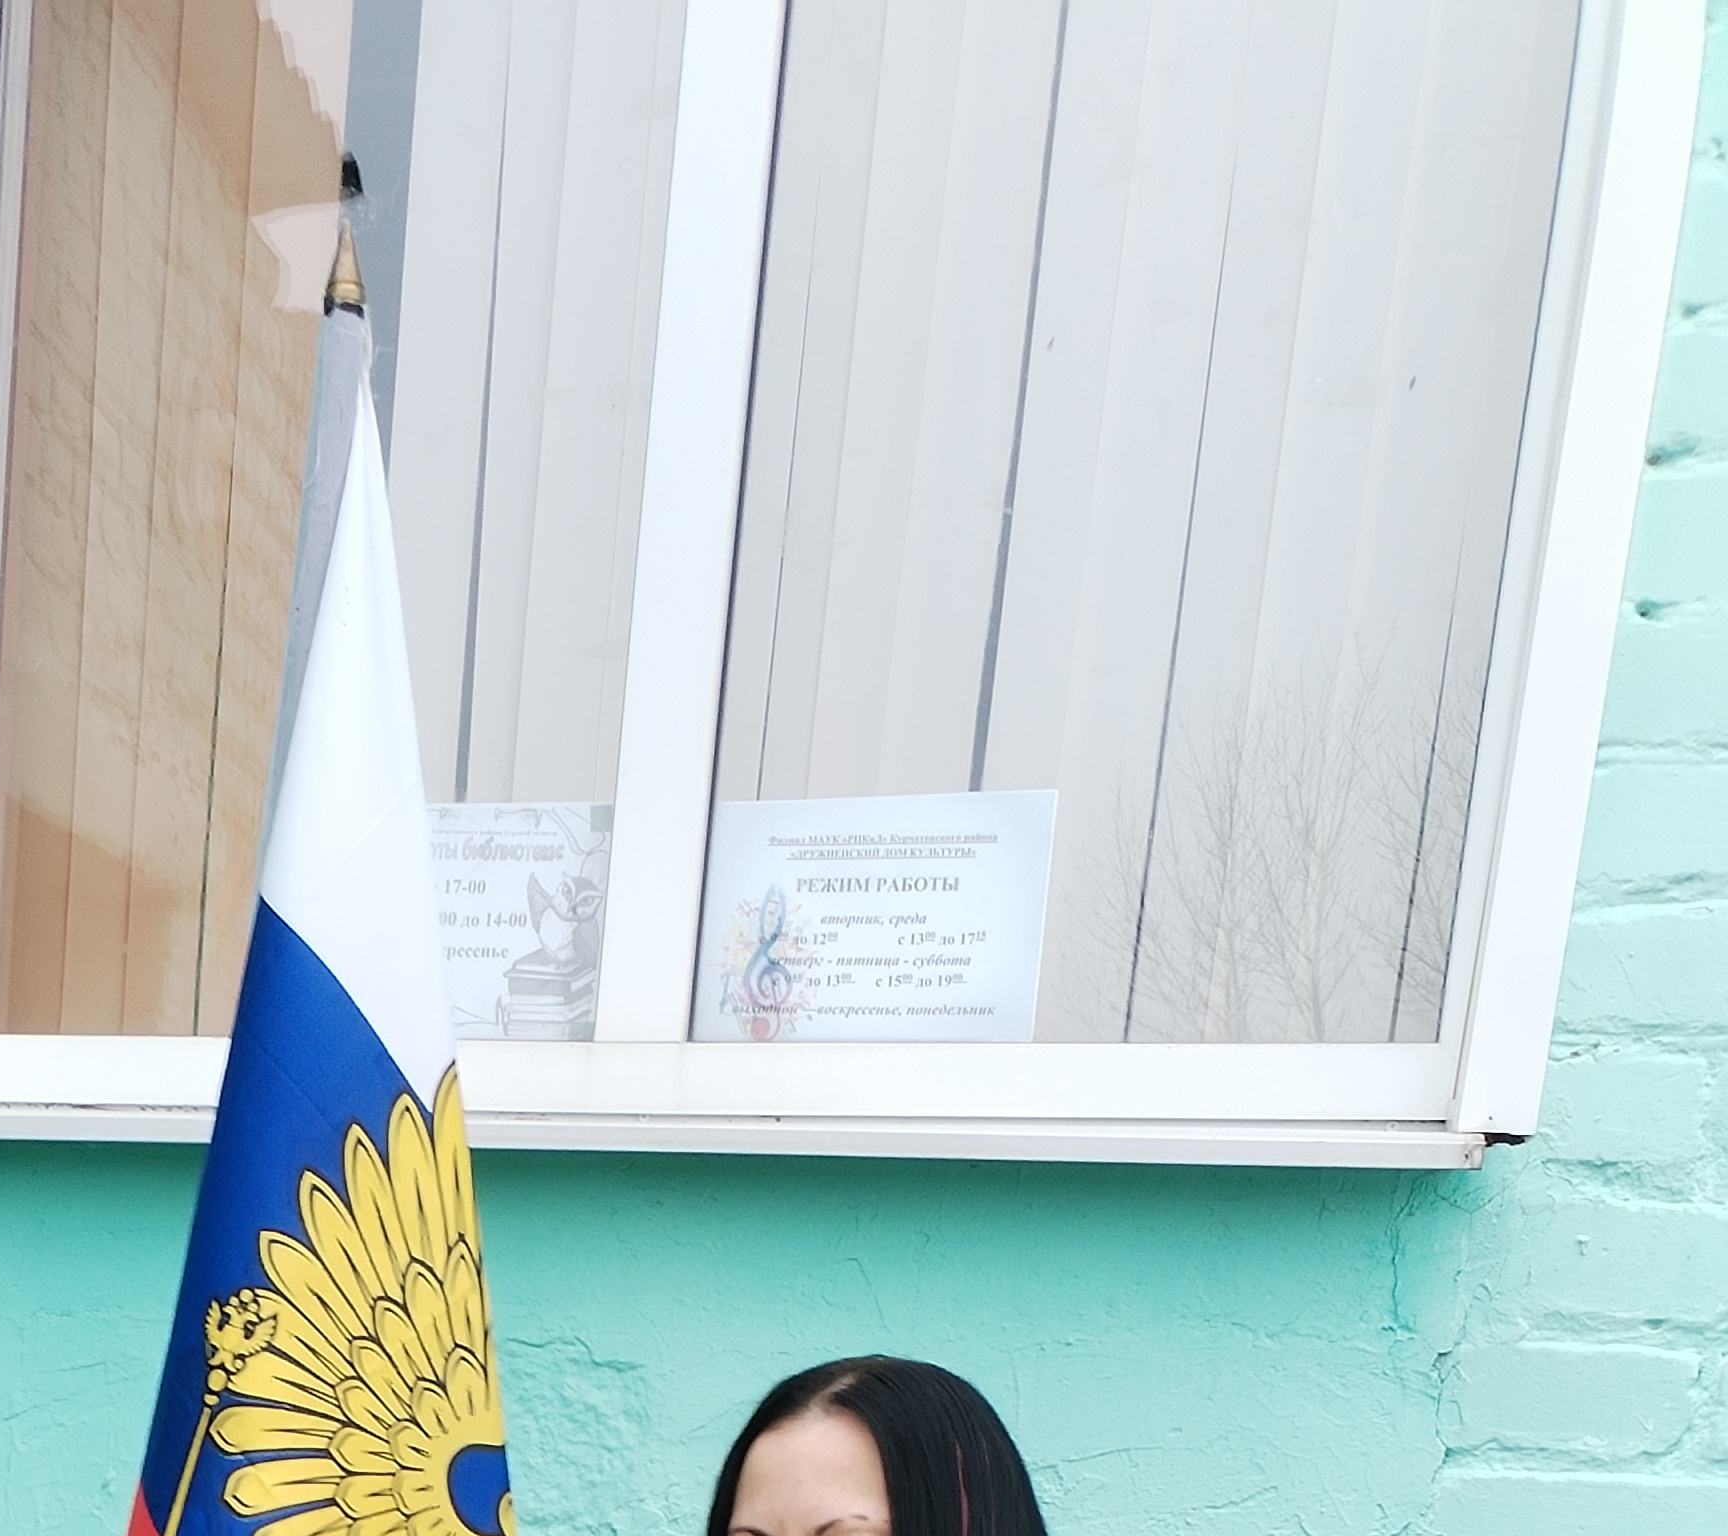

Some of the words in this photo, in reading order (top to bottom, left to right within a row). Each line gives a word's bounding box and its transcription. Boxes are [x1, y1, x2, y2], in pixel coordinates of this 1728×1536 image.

[882, 847, 907, 859] ДОМ
[445, 879, 486, 894] 17-00
[796, 877, 871, 893] РЕЖИМ
[876, 876, 960, 893] РАБОТЫ
[460, 916, 480, 928] до
[486, 912, 527, 928] 14-00
[820, 915, 884, 928] вторник,
[889, 912, 927, 928] среда
[793, 935, 808, 945] до
[898, 936, 906, 945] с
[938, 935, 955, 946] до
[836, 956, 900, 969] пятница
[912, 953, 972, 970] суббота
[805, 977, 821, 987] до
[875, 977, 883, 987] с
[915, 977, 932, 988] до
[906, 1003, 997, 1016] понедельник
